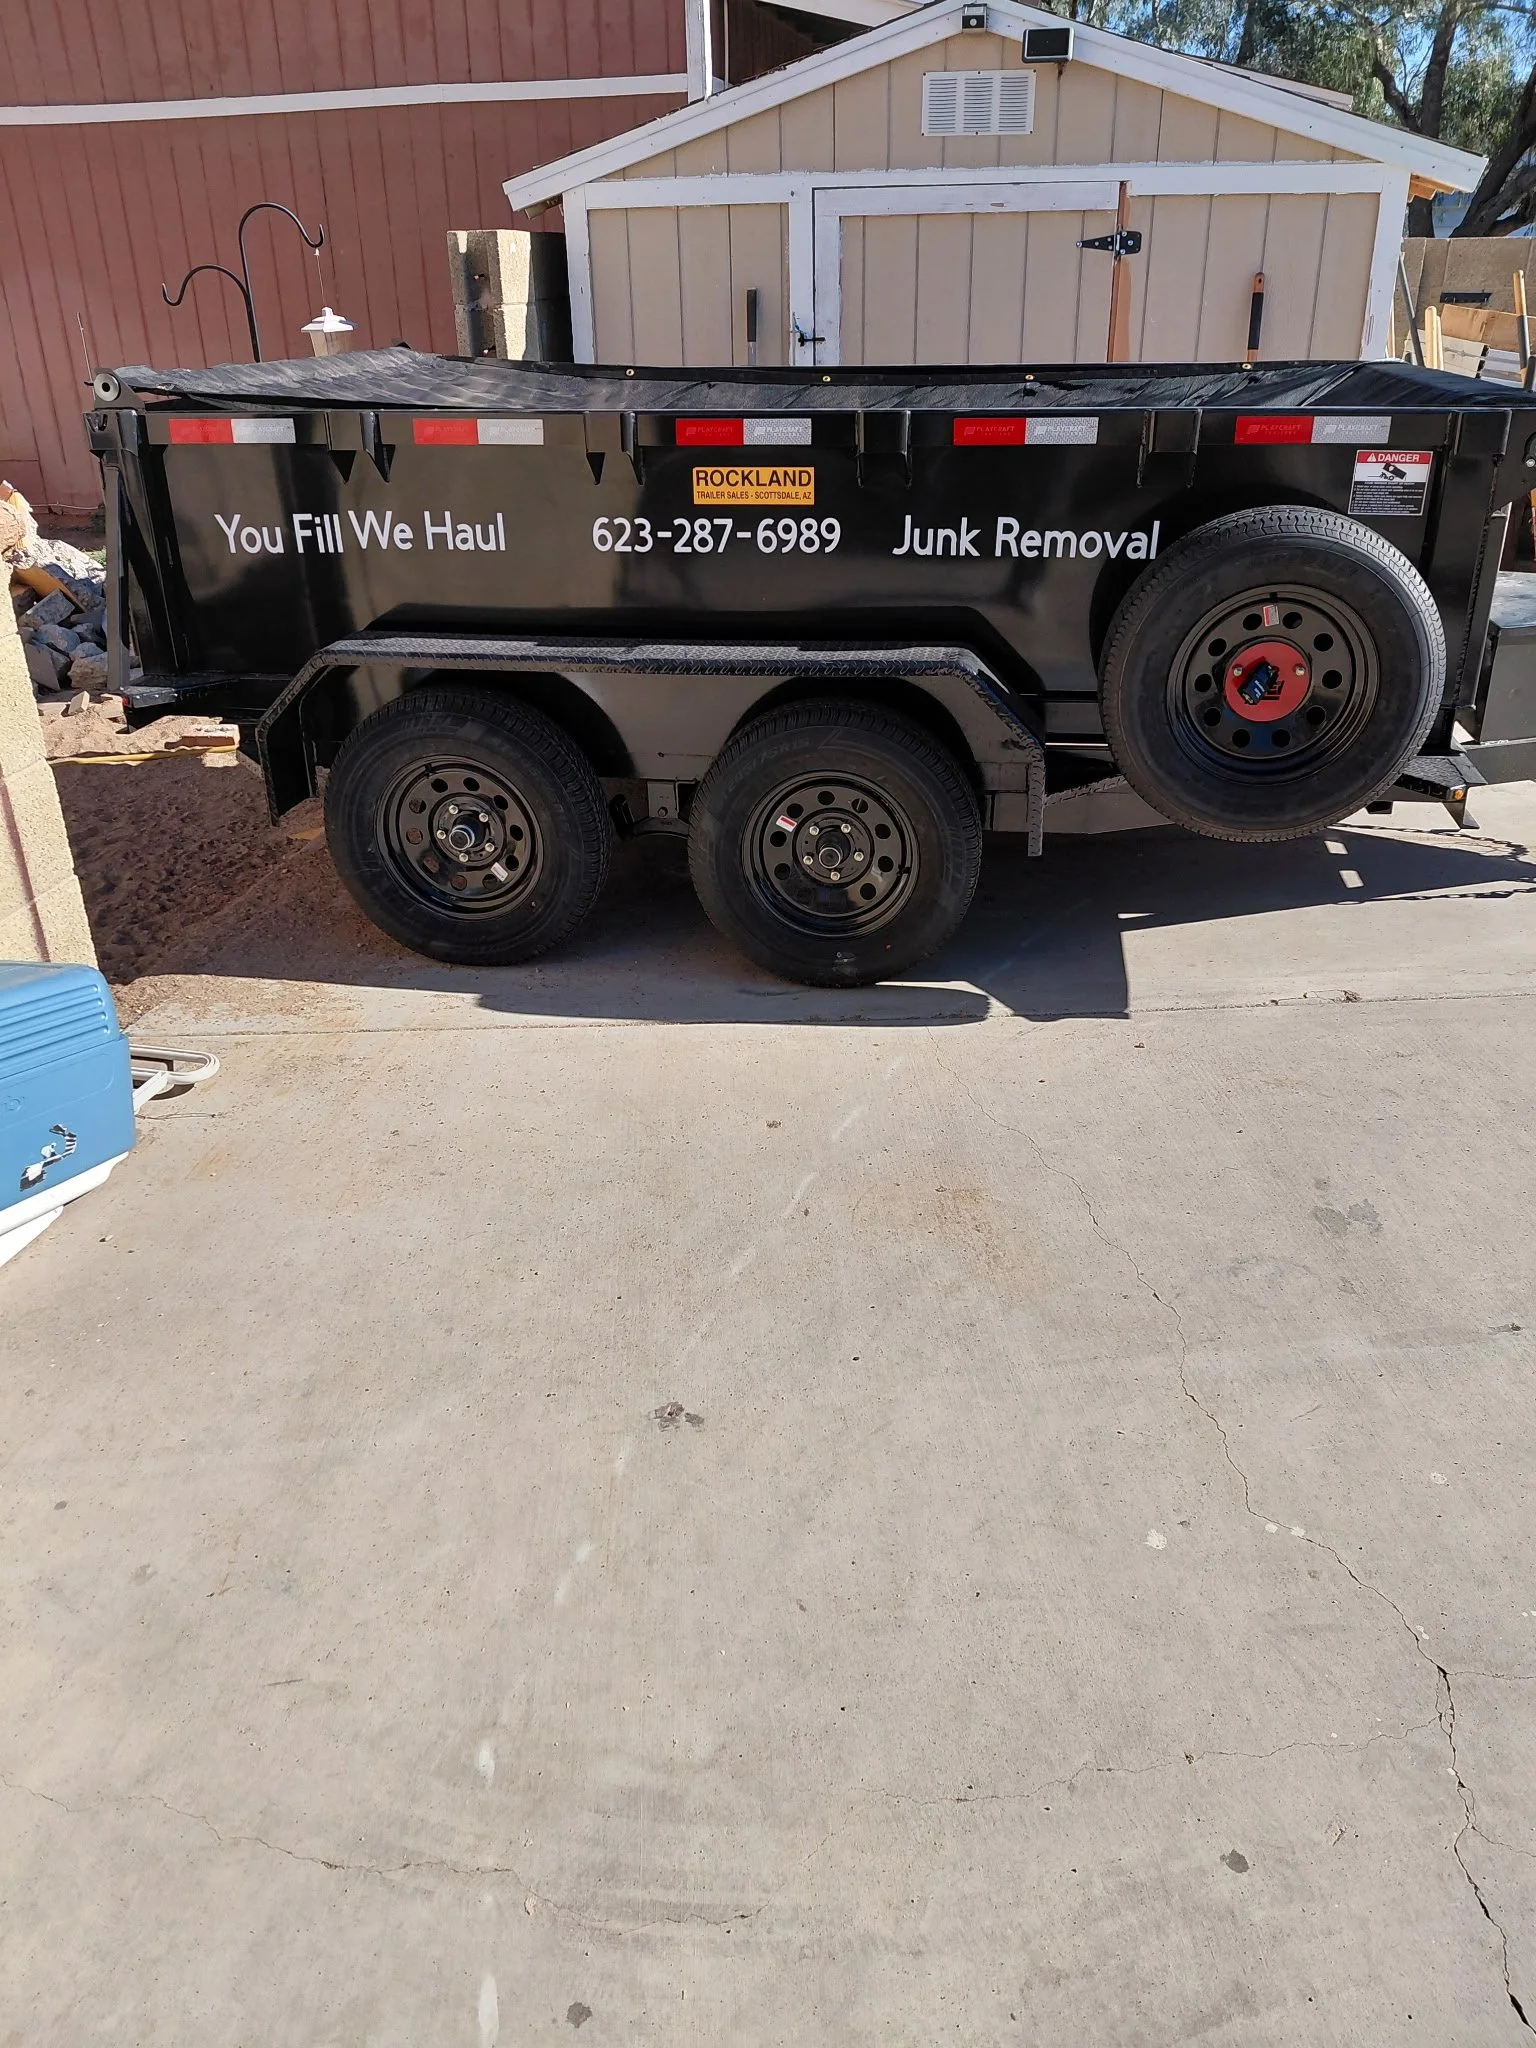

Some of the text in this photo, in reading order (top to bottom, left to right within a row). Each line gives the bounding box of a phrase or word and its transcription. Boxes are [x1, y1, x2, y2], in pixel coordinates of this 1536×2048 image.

[1377, 453, 1420, 463] DANGER
[695, 469, 812, 487] ROCKLAND
[696, 490, 726, 500] TRAILER
[726, 490, 749, 500] SALES
[754, 491, 802, 501] SCOTTSDALE,
[802, 491, 812, 500] AZ
[213, 510, 507, 554] You Fill We Haul
[591, 516, 842, 554] 623-287-6989
[891, 514, 1161, 560] Junk Removal
